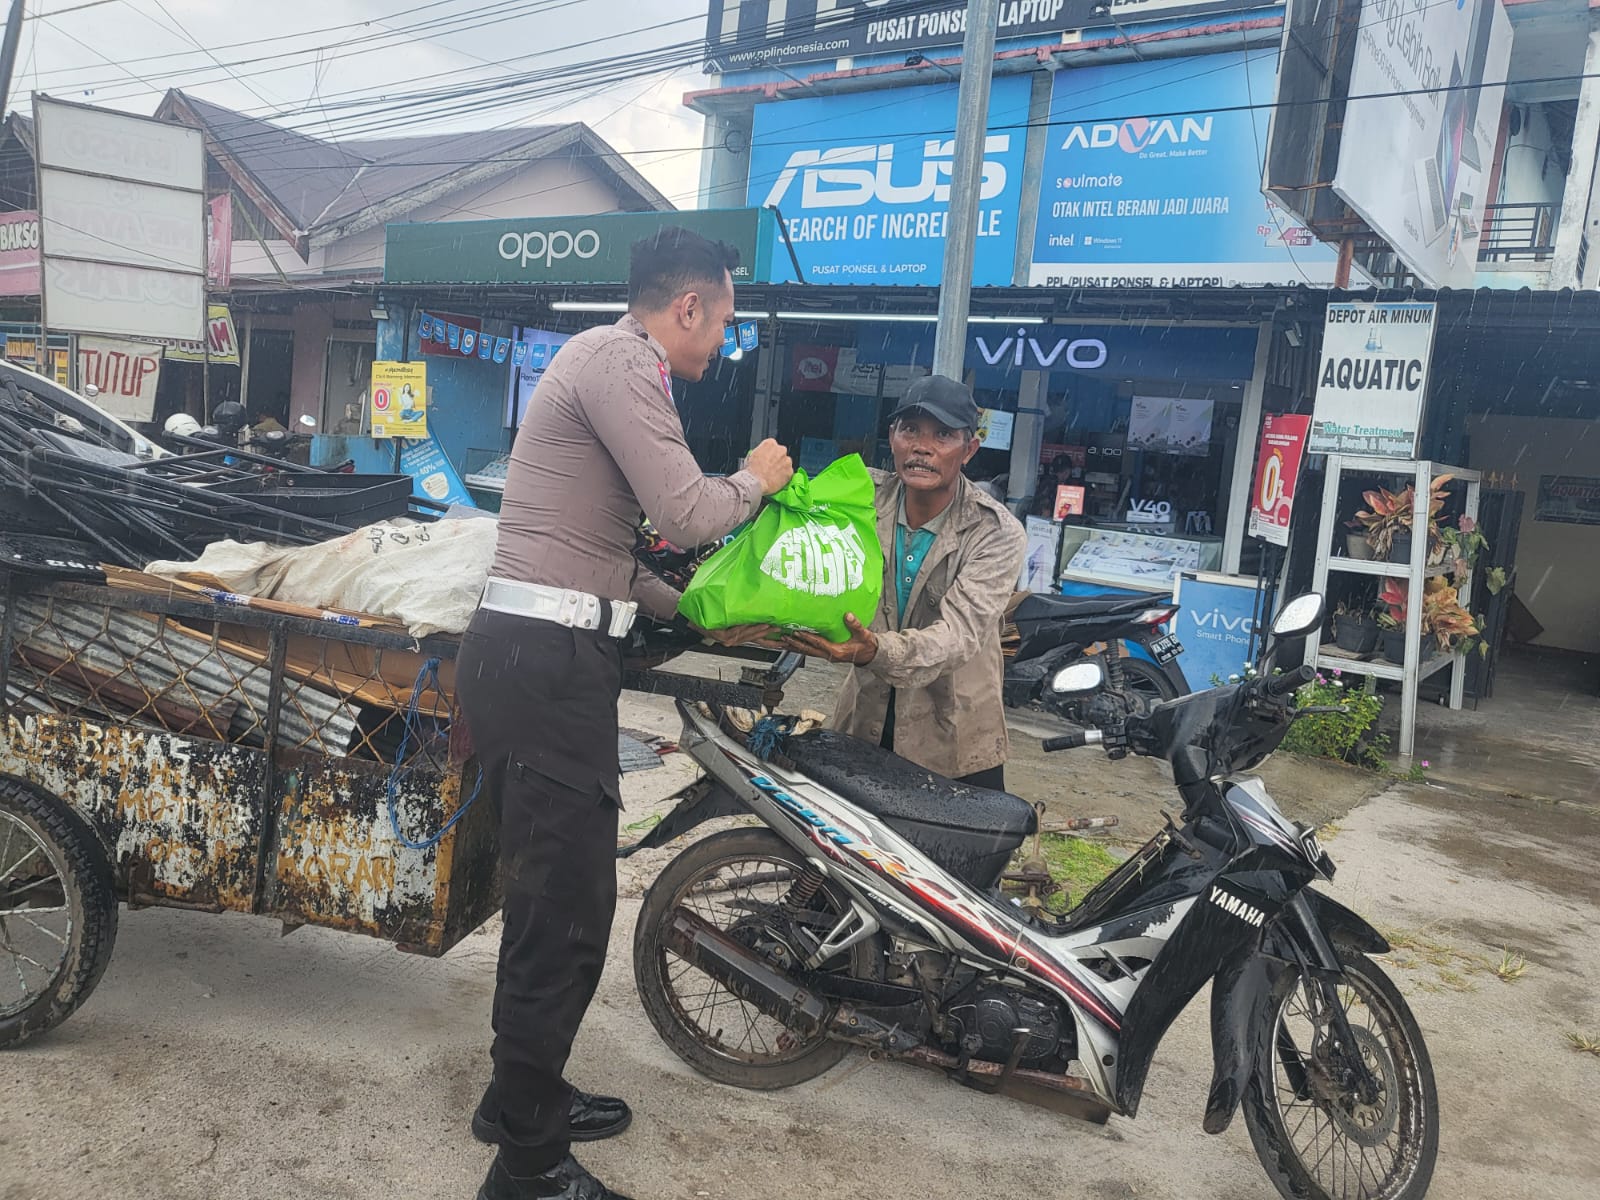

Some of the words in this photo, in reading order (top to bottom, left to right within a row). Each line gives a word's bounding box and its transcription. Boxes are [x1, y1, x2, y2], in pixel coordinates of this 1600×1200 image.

[866, 16, 915, 45] PUSAT
[917, 9, 967, 38] PONSE
[998, 0, 1064, 27] LAPTOP
[728, 38, 850, 63] www.pplindonesia.com
[1061, 115, 1214, 153] ADVAN
[763, 134, 1010, 209] ASUS
[1056, 172, 1123, 189] soulmate
[1052, 201, 1080, 218] OTAK
[1082, 199, 1115, 217] INTEL
[1117, 198, 1160, 216] BERANI
[1161, 197, 1187, 215] JADI
[1189, 196, 1230, 214] JUARA
[0, 219, 39, 250] BAKSO
[778, 213, 848, 244] SEARCH
[852, 213, 876, 240] OF
[1049, 233, 1074, 247] intel
[812, 264, 840, 275] PUSAT
[842, 264, 879, 275] PONSEL
[880, 264, 887, 274] &
[889, 262, 927, 274] LAPTOP
[1046, 276, 1066, 287] PPL
[1328, 309, 1366, 324] DEPOT
[1367, 310, 1388, 324] AIR
[1390, 310, 1432, 325] MINUM
[975, 327, 1107, 369] vivo
[79, 349, 157, 397] TUTUP
[1321, 357, 1422, 392] AQUATIC
[1323, 422, 1351, 434] Water
[1354, 425, 1404, 438] Treatment
[1129, 498, 1171, 515] V40
[1196, 629, 1222, 641] Smart
[1209, 885, 1265, 928] YAMAHA
